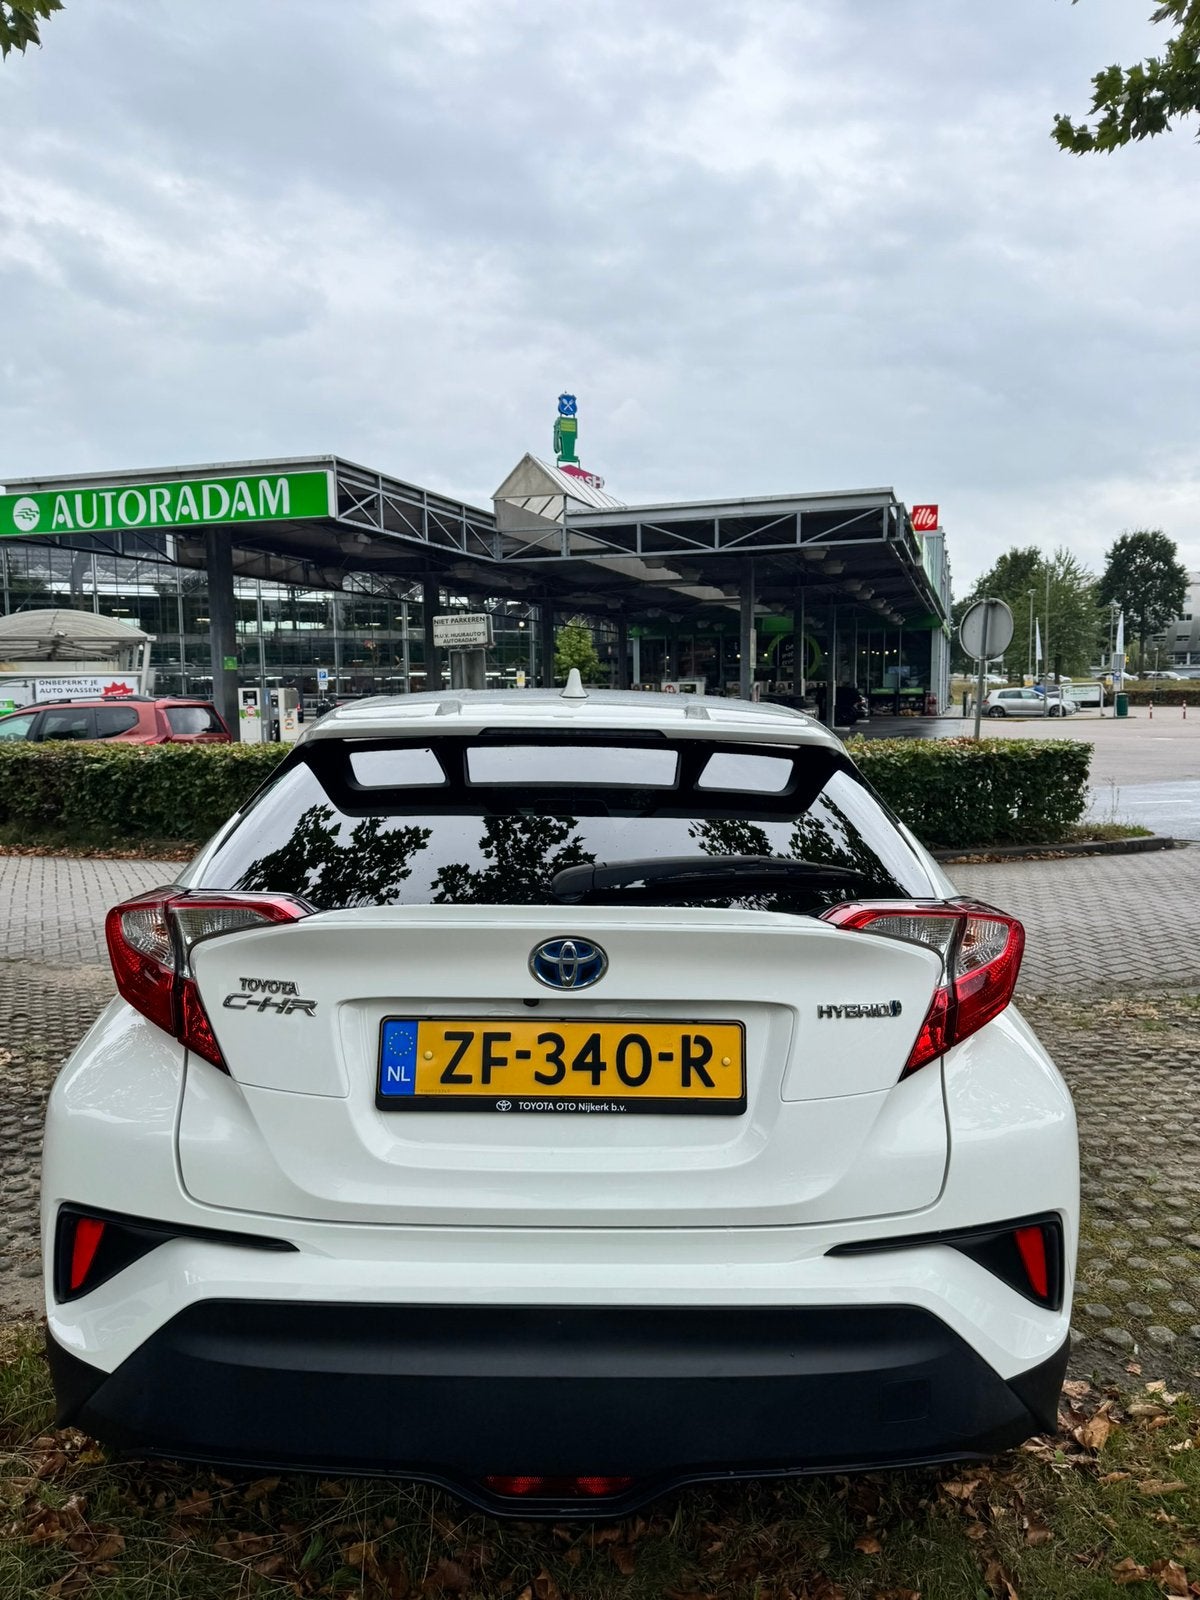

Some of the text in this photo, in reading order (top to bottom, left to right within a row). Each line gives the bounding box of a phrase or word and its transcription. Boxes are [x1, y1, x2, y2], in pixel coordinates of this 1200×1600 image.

[573, 474, 604, 489] ASH
[51, 477, 290, 529] AUTORADAM
[914, 508, 936, 528] illy
[450, 616, 485, 624] PARKEREN
[66, 686, 102, 694] WASSEN!
[239, 977, 300, 996] TOYOTA
[222, 993, 318, 1017] C-HR
[817, 1003, 890, 1019] HYBRID
[440, 1031, 715, 1087] ZF-340-R
[387, 1066, 411, 1082] NL
[518, 1101, 627, 1113] TOYOTA OTO Nijkerk b.v.
